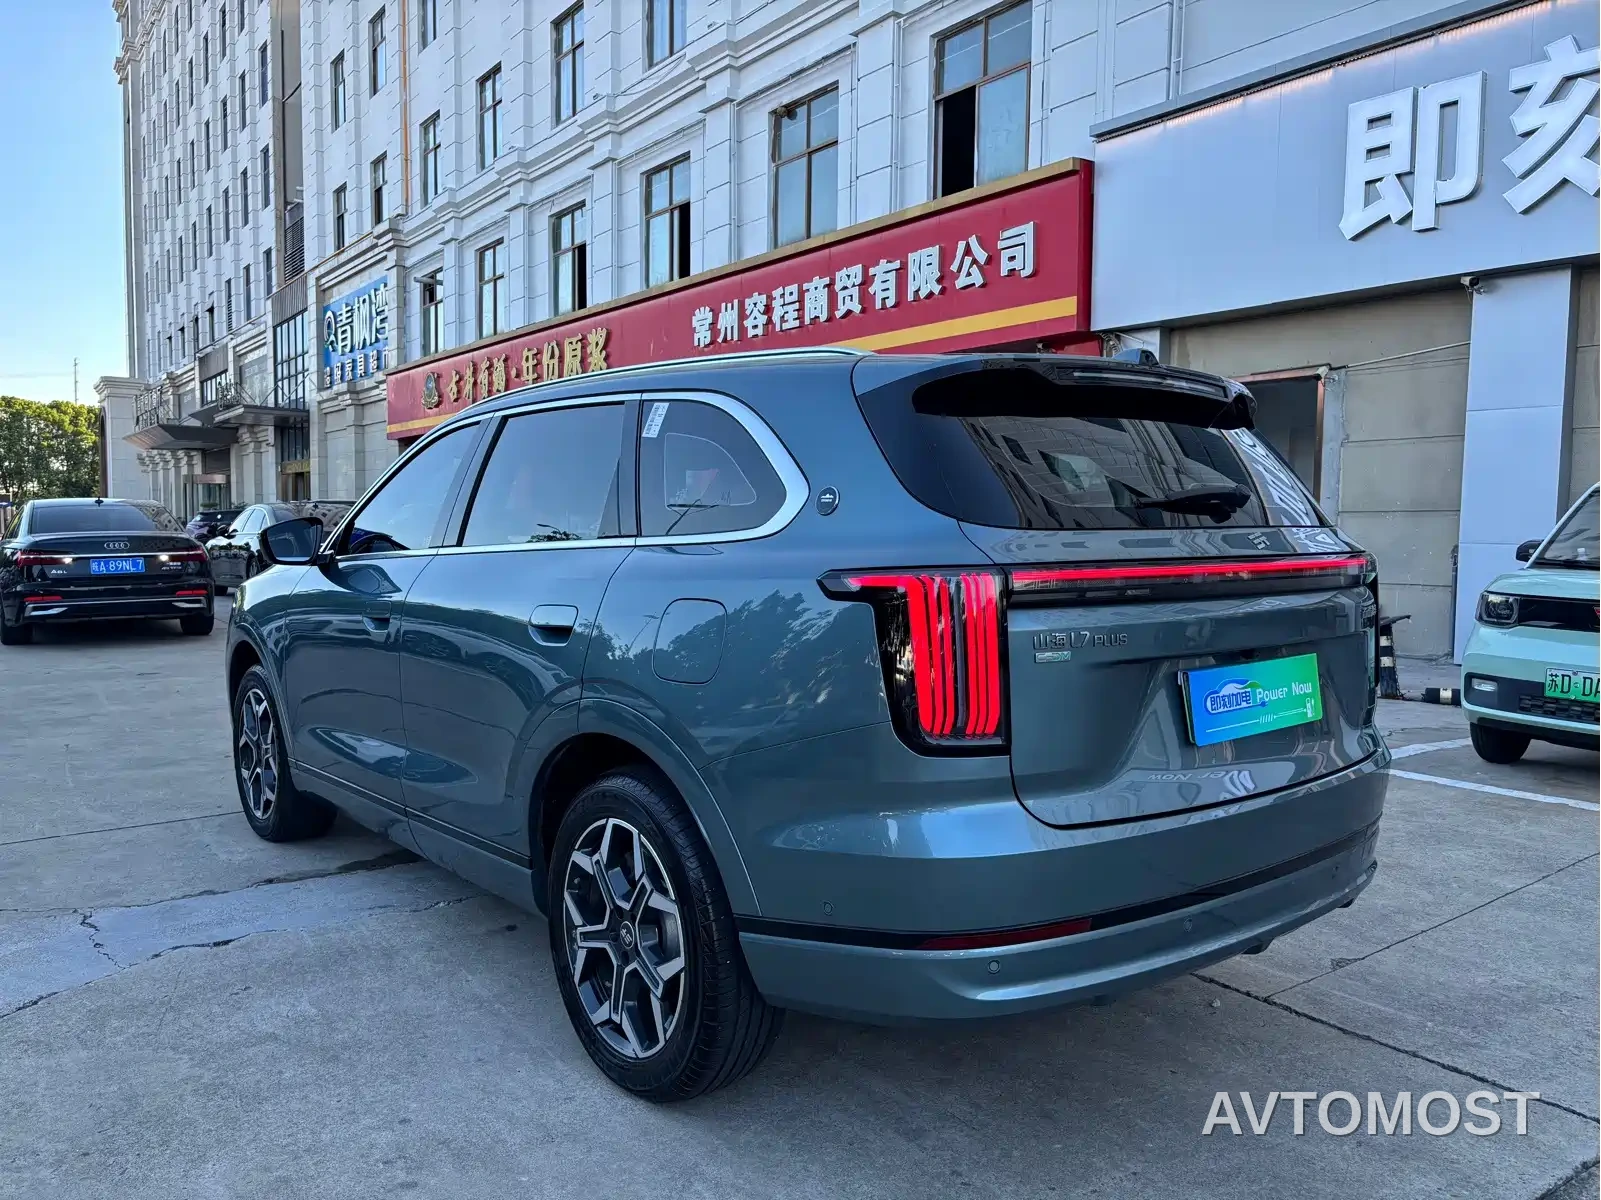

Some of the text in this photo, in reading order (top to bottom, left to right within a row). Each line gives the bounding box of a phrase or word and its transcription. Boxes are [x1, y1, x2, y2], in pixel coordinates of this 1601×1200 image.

[692, 221, 1037, 348] 常州容程商贸有限公司
[336, 283, 389, 355] 青枫湾
[1093, 633, 1128, 647] PLUS
[1210, 681, 1313, 712] 即刻加电 Power Now
